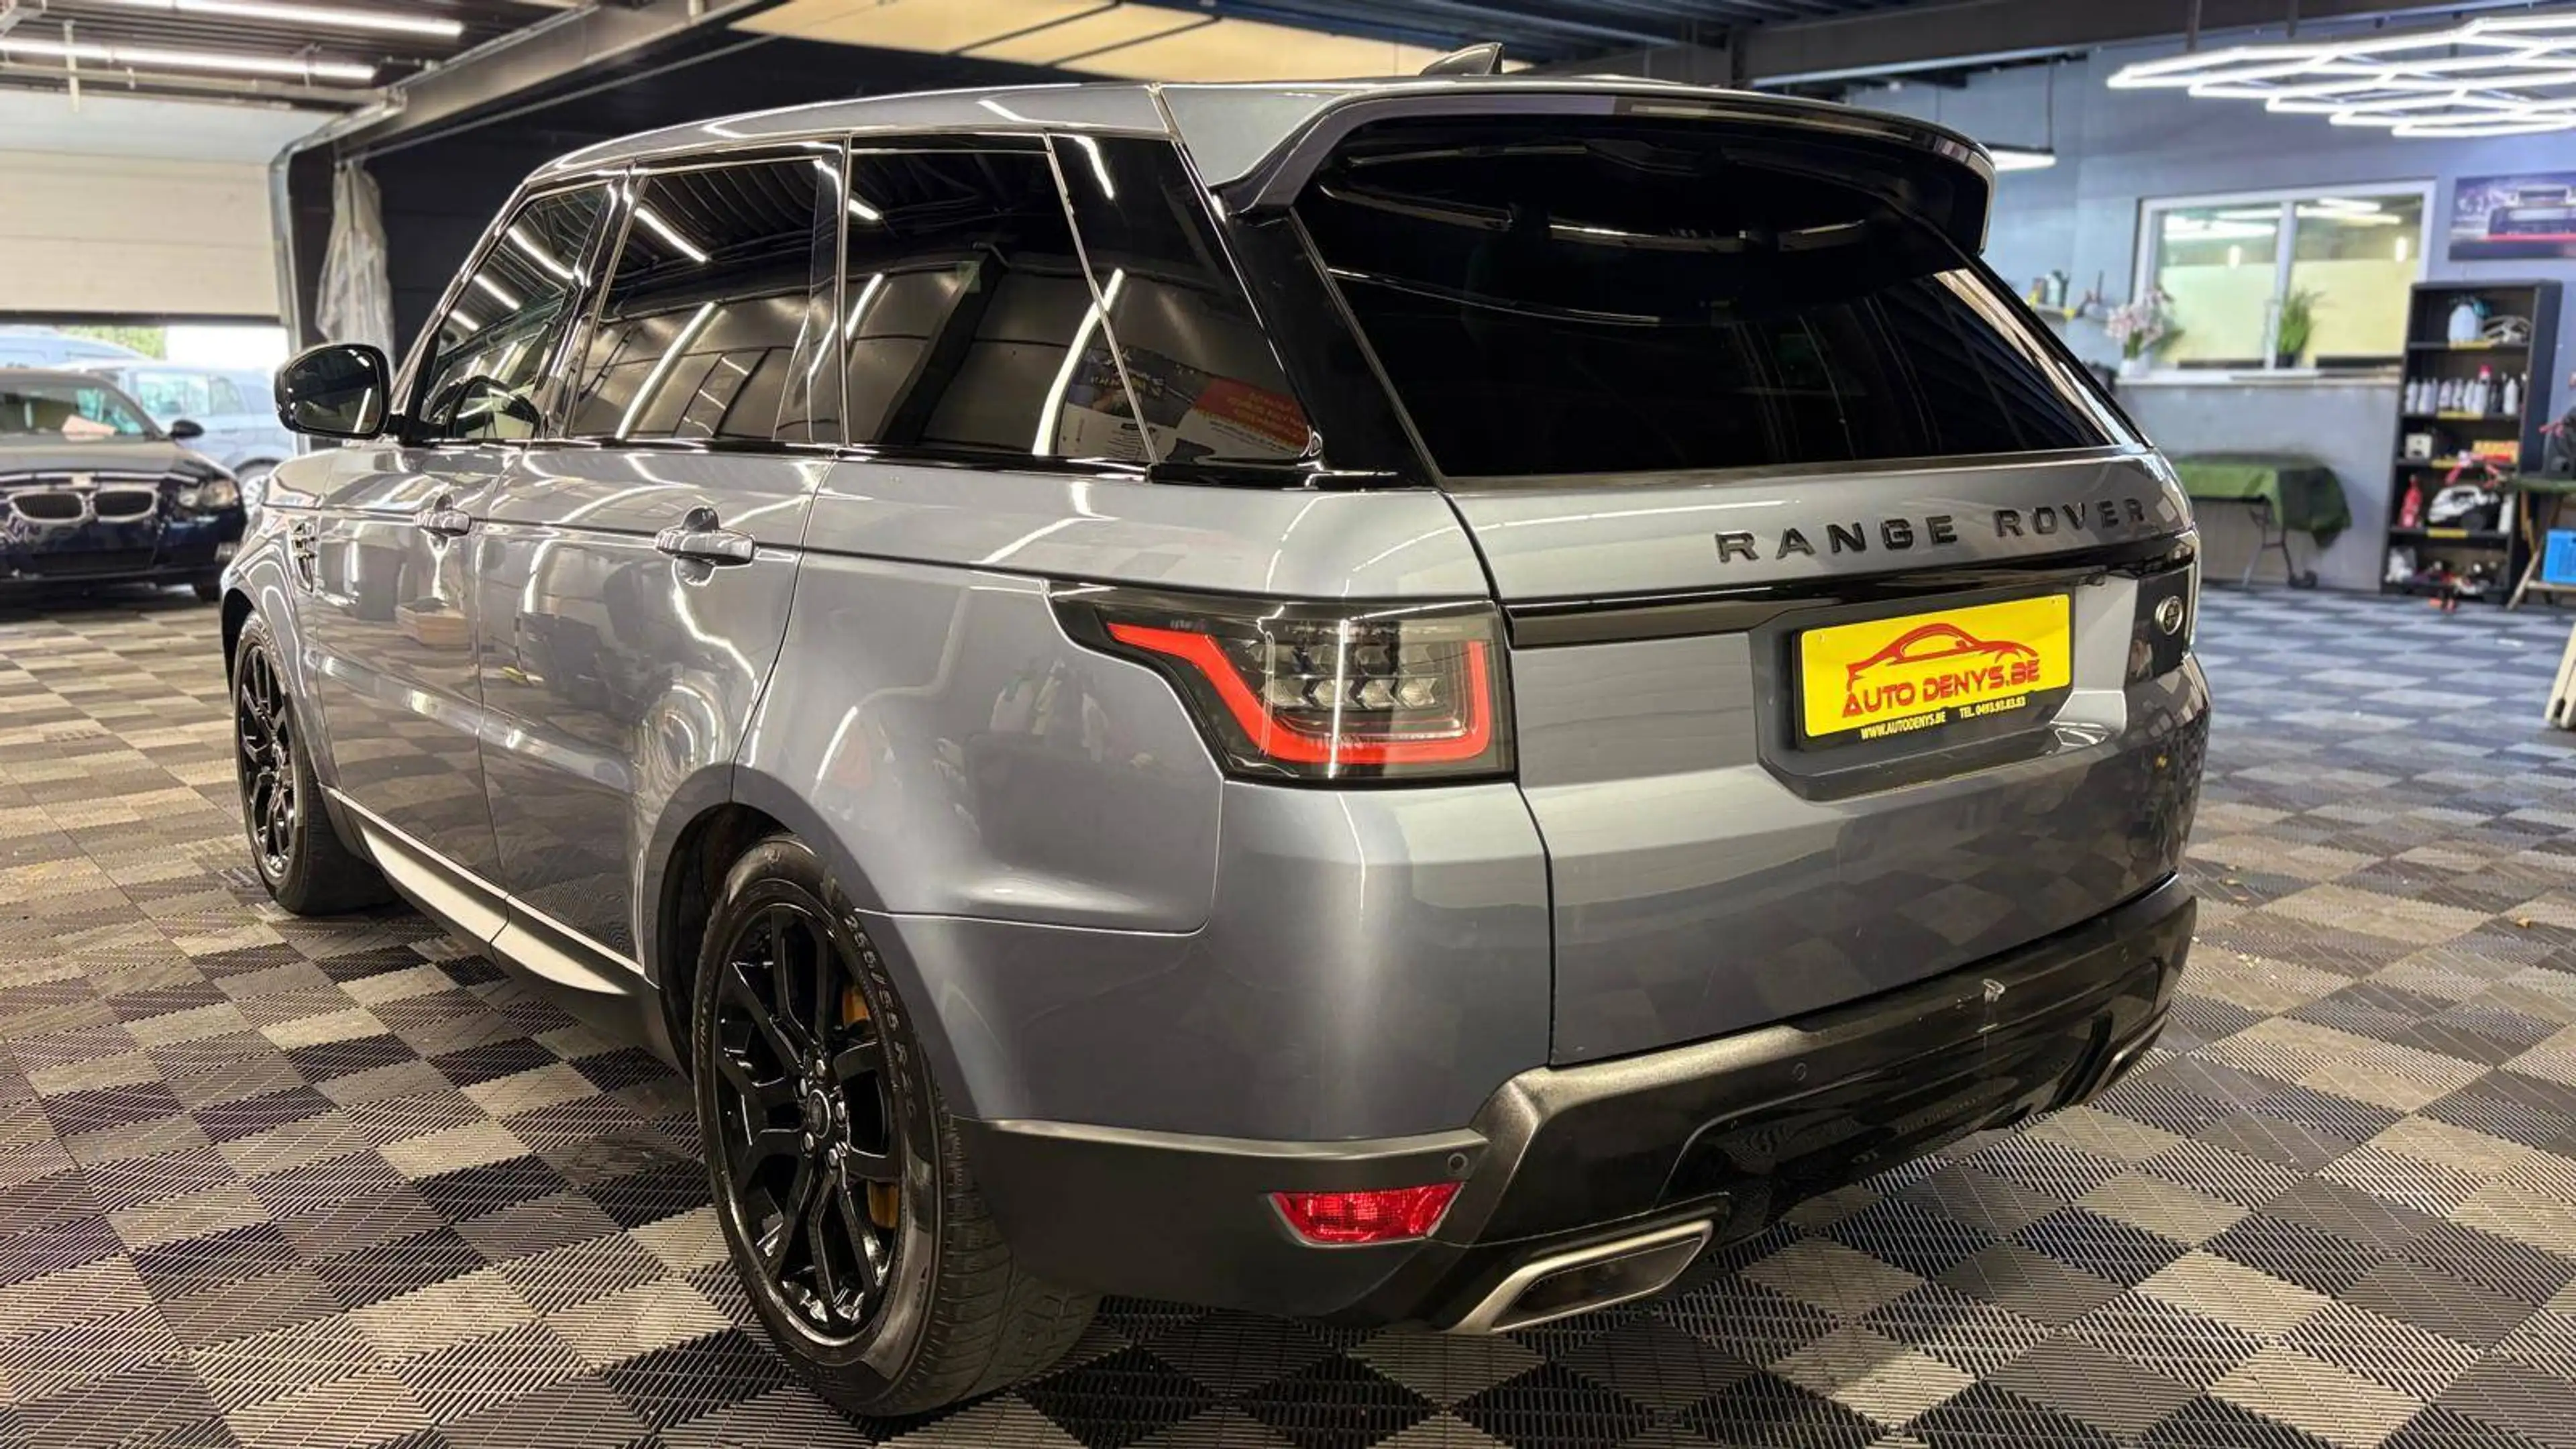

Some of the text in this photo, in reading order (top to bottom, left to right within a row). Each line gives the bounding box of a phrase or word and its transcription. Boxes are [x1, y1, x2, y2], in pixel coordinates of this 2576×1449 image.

[1715, 498, 2146, 564] RANGE ROVER
[1841, 658, 2041, 718] AUTO DENYS.BE
[1860, 711, 1946, 740] WWW.AUTODENYS.BE
[1959, 706, 1975, 719] TEL.
